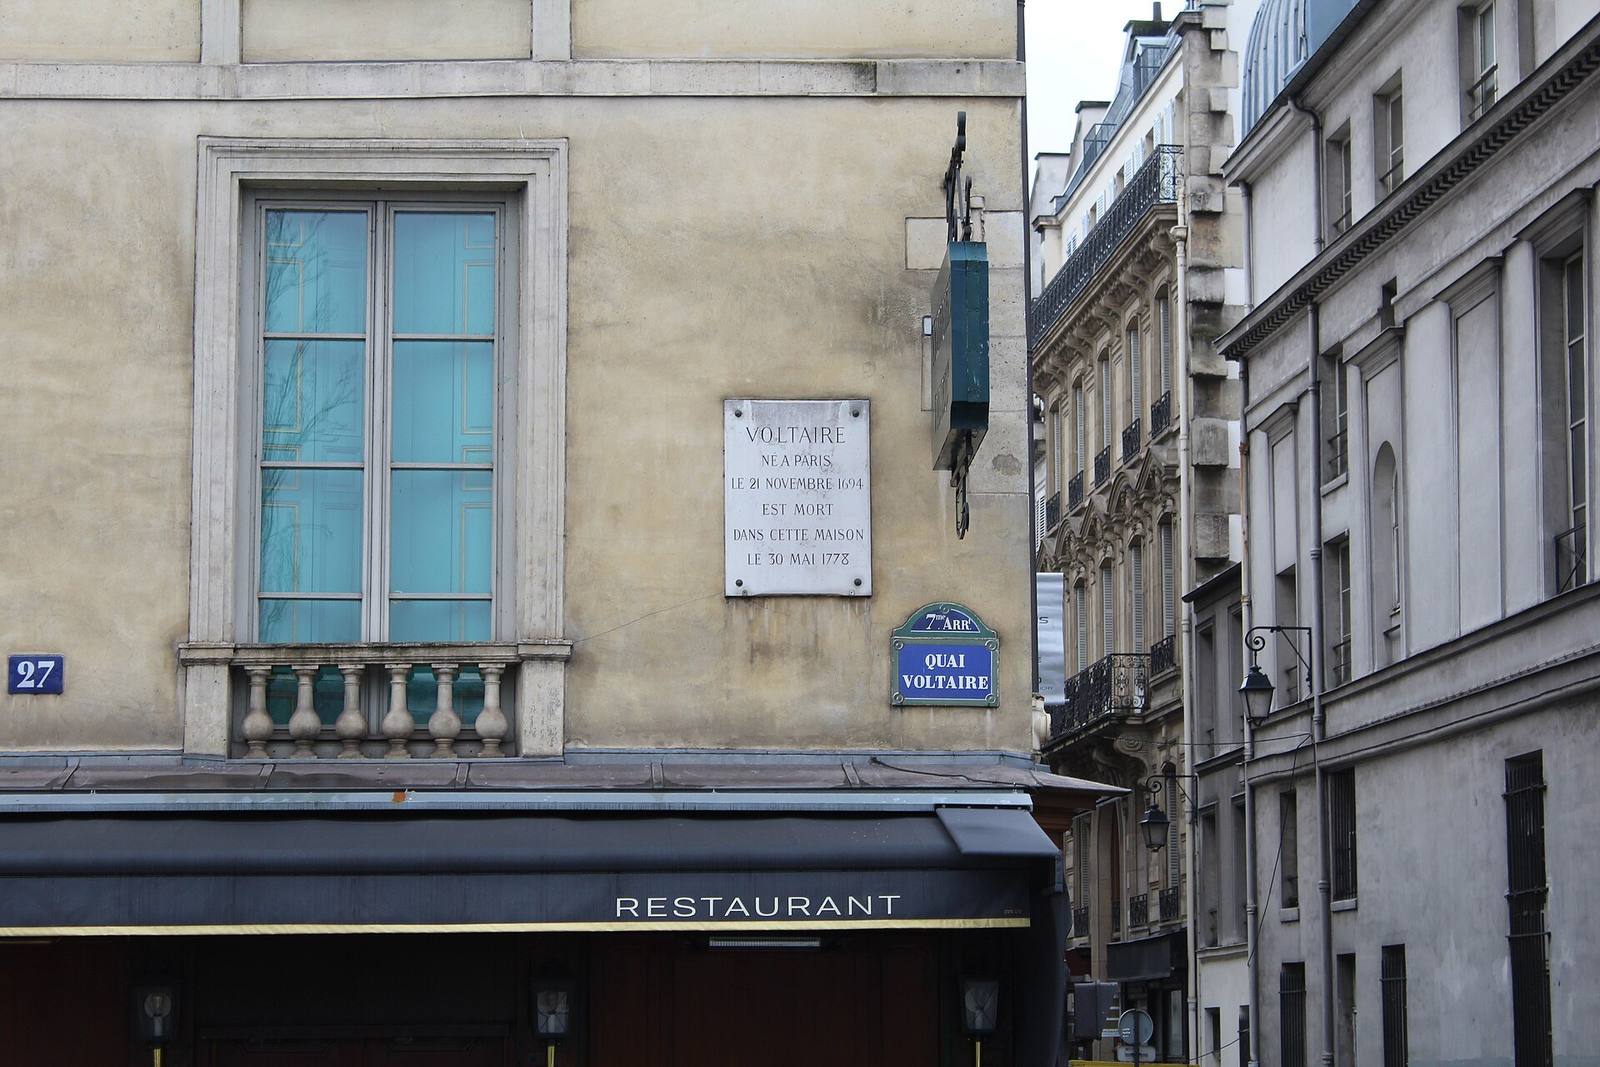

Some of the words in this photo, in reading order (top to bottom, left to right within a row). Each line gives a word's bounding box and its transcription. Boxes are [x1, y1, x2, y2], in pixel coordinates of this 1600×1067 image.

[746, 427, 846, 443] VOLTAIRE
[794, 455, 832, 466] PARIS
[731, 478, 744, 489] LE
[750, 478, 760, 489] 21
[765, 478, 832, 489] NOVEMBRE
[838, 478, 864, 489] 1694
[762, 503, 786, 515] EST
[794, 503, 834, 515] MORT
[733, 529, 764, 540] DANS
[770, 529, 808, 540] CETTE
[814, 529, 864, 540] MAISON
[747, 554, 761, 565] LE
[769, 553, 783, 565] 30
[790, 554, 815, 565] MAI
[822, 553, 850, 565] 1778
[925, 653, 965, 670] QUAI
[16, 660, 55, 688] 27
[902, 674, 989, 690] VOLTAIRE
[616, 895, 901, 917] RESTAURANT
